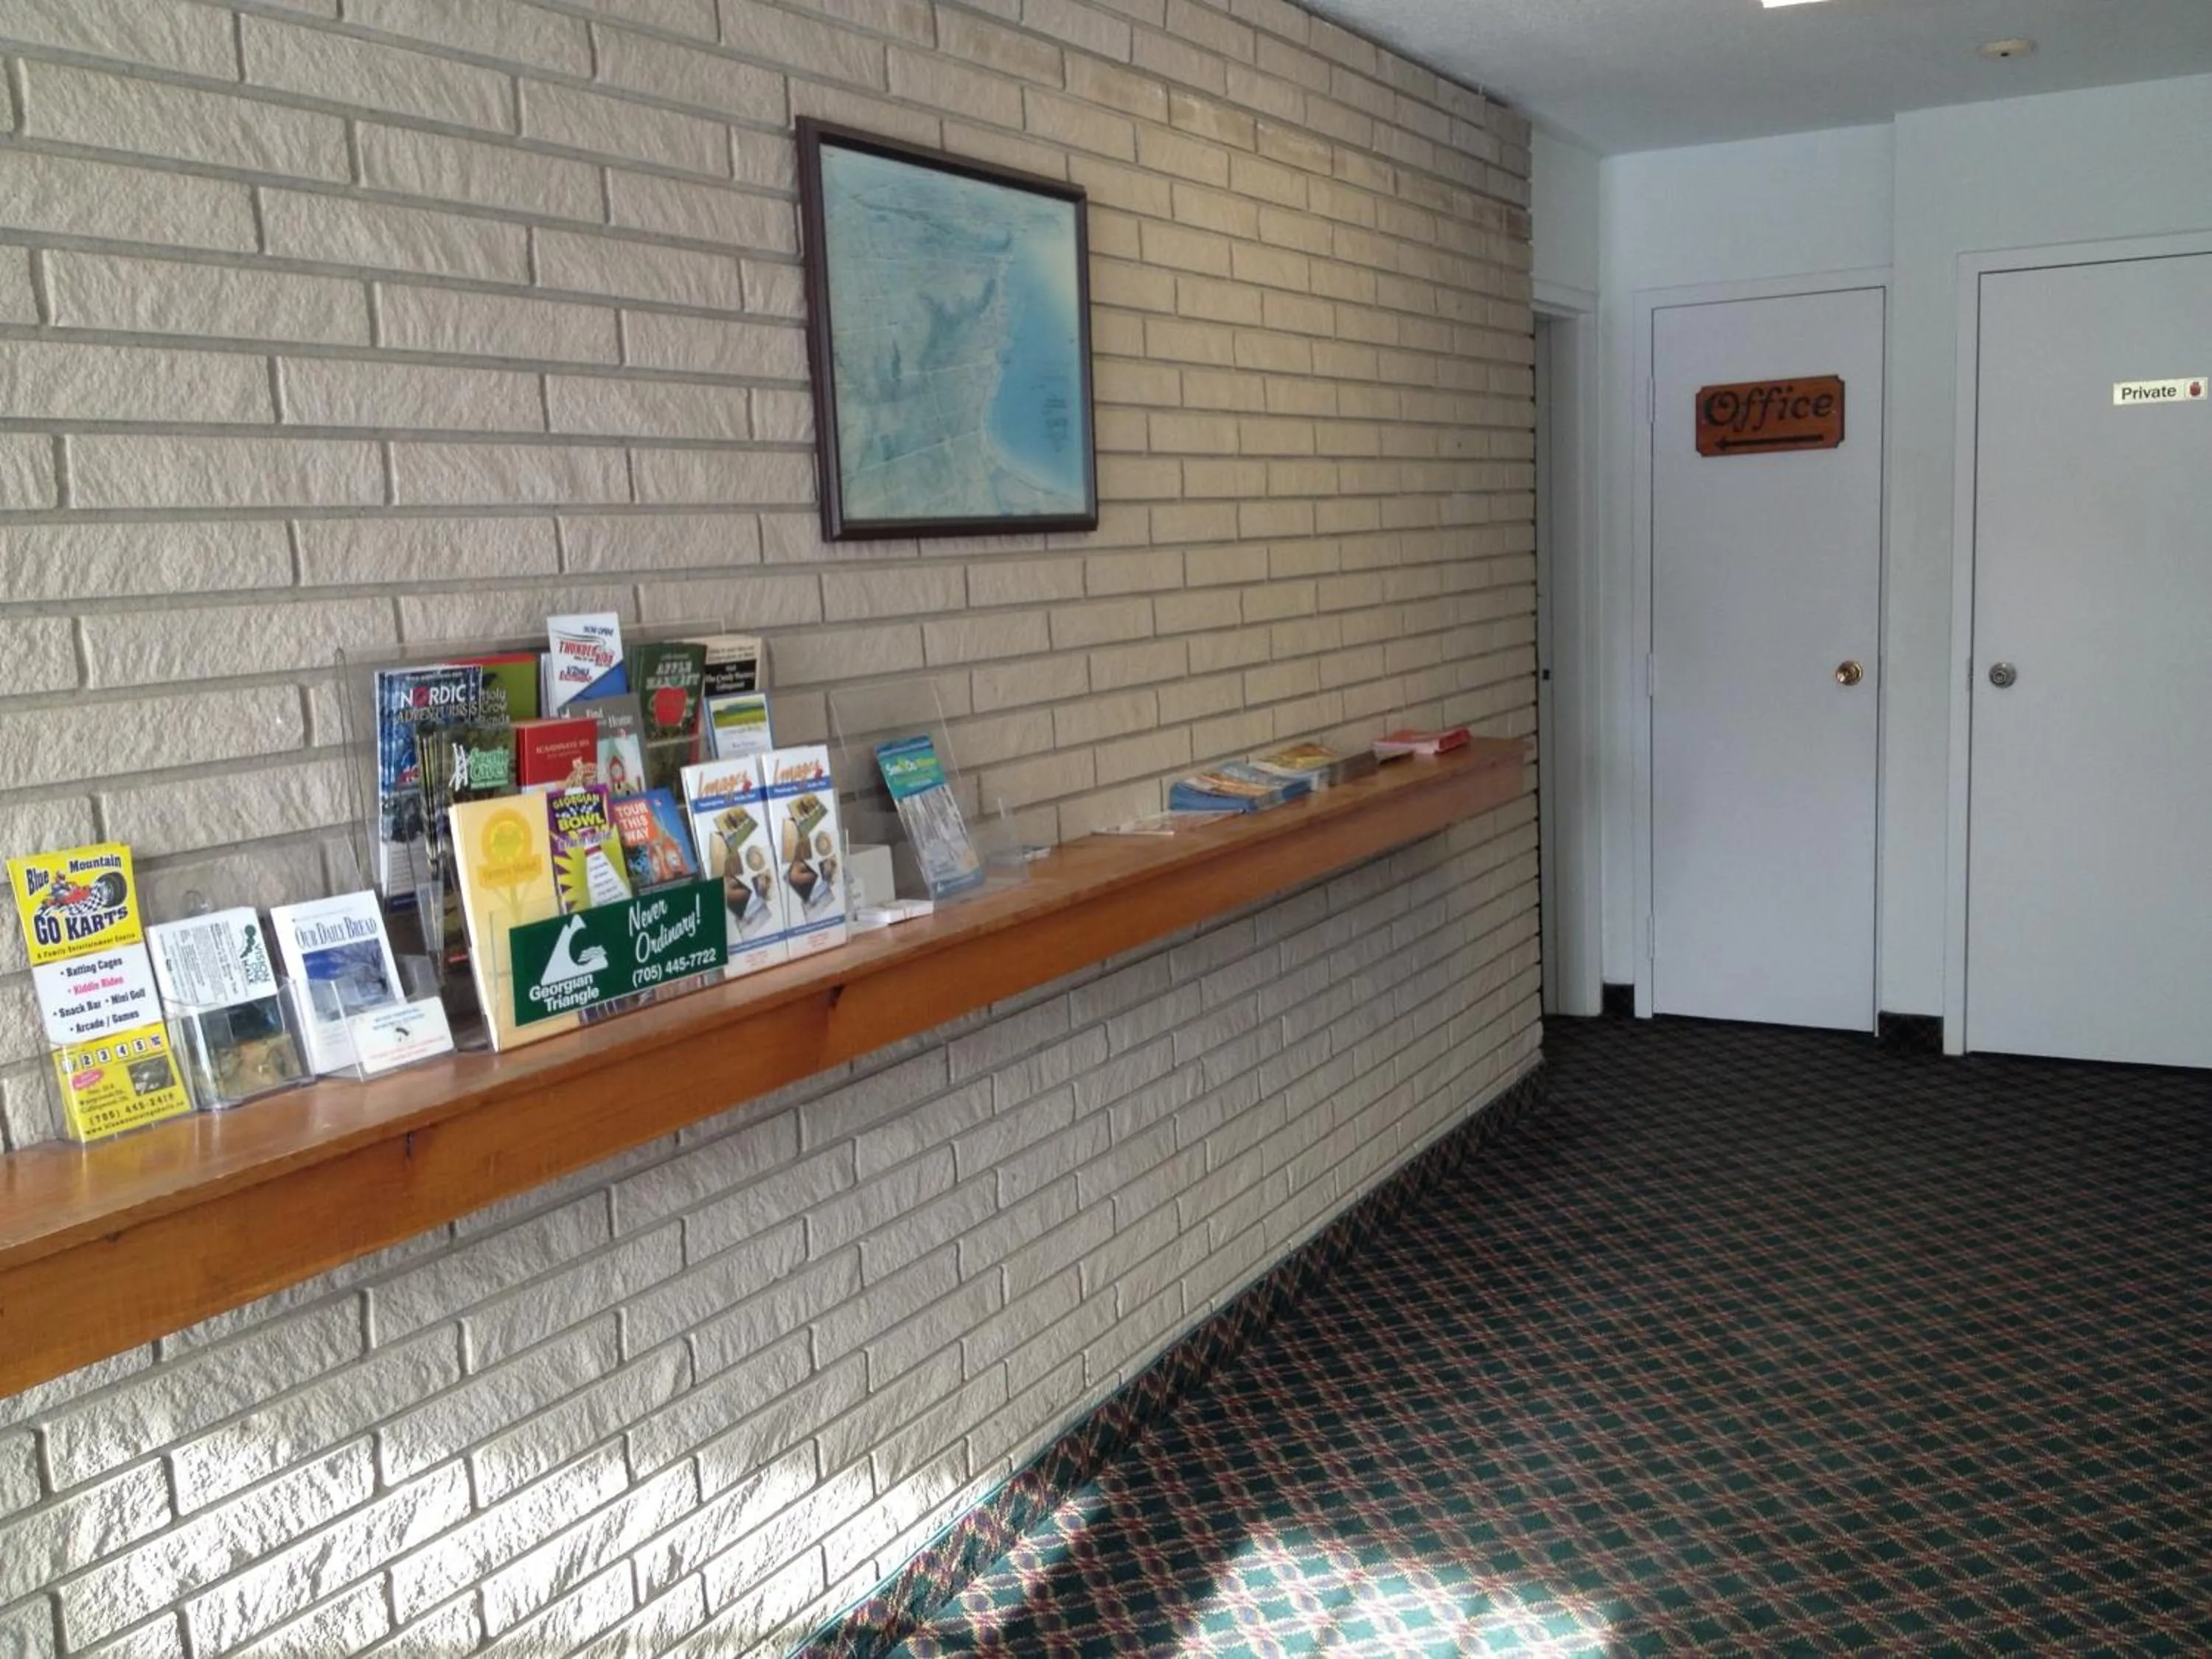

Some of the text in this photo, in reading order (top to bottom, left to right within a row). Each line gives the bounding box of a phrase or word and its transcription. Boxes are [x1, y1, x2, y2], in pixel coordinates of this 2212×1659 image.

[2121, 386, 2177, 400] Private
[1704, 386, 1834, 432] Office
[400, 684, 466, 709] NORDIC
[470, 762, 509, 780] Caves
[553, 793, 600, 809] GEORGIAN
[616, 801, 649, 815] TOUR
[557, 813, 605, 832] BOWL
[619, 814, 648, 828] THIS
[625, 827, 650, 842] WAY
[27, 854, 122, 897] Blue Mountain
[34, 905, 128, 945] GO KARTS
[629, 899, 667, 936] Never
[636, 894, 701, 963] Ordinary!
[295, 916, 377, 950] OUR DAILY BREAD
[66, 958, 123, 977] Batting Cages
[254, 944, 272, 981] VISION
[633, 963, 663, 987] (705)
[665, 947, 716, 974] 445-7722
[74, 976, 124, 995] Kiddie Rides
[529, 974, 594, 1001] Georgian
[59, 988, 146, 1018] Snack Bar Mini Golf
[544, 986, 599, 1012] Triangle
[76, 1018, 105, 1033] Arcade
[112, 1010, 139, 1023] Games
[83, 1055, 91, 1065] 2
[119, 1046, 126, 1055] 4
